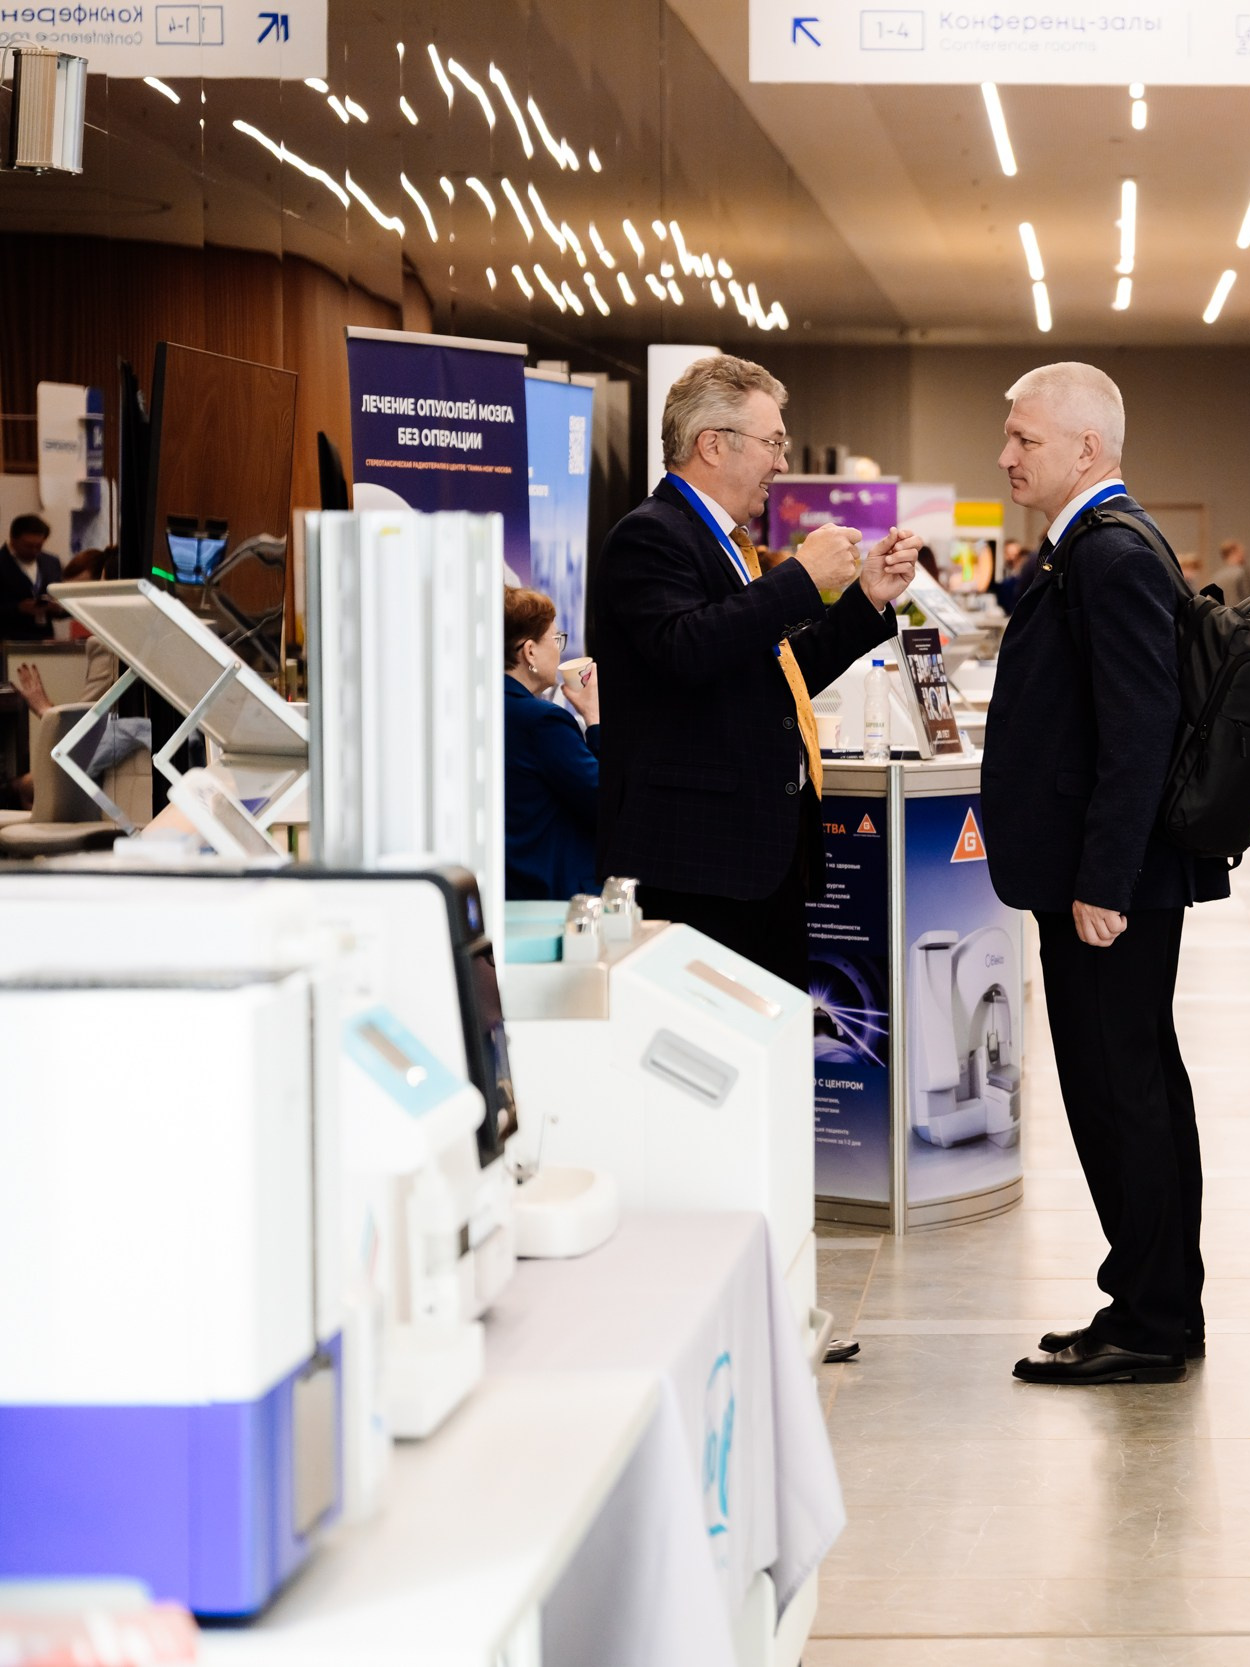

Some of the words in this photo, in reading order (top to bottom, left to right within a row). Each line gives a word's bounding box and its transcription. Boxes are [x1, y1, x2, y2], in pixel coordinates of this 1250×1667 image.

[876, 21, 909, 39] 1-4
[939, 11, 1162, 33] Конференц-залы
[939, 38, 1043, 53] Conference
[1046, 38, 1097, 53] rooms
[361, 394, 415, 415] ЛЕЧЕНИЕ
[416, 398, 478, 421] ОПУХОЛЕЙ
[478, 404, 514, 423] МОЗГА
[397, 427, 419, 446] БЕЗ
[421, 429, 483, 452] ОПЕРАЦИИ
[964, 831, 977, 852] G
[825, 1079, 864, 1091] ЦЕНТРОМ
